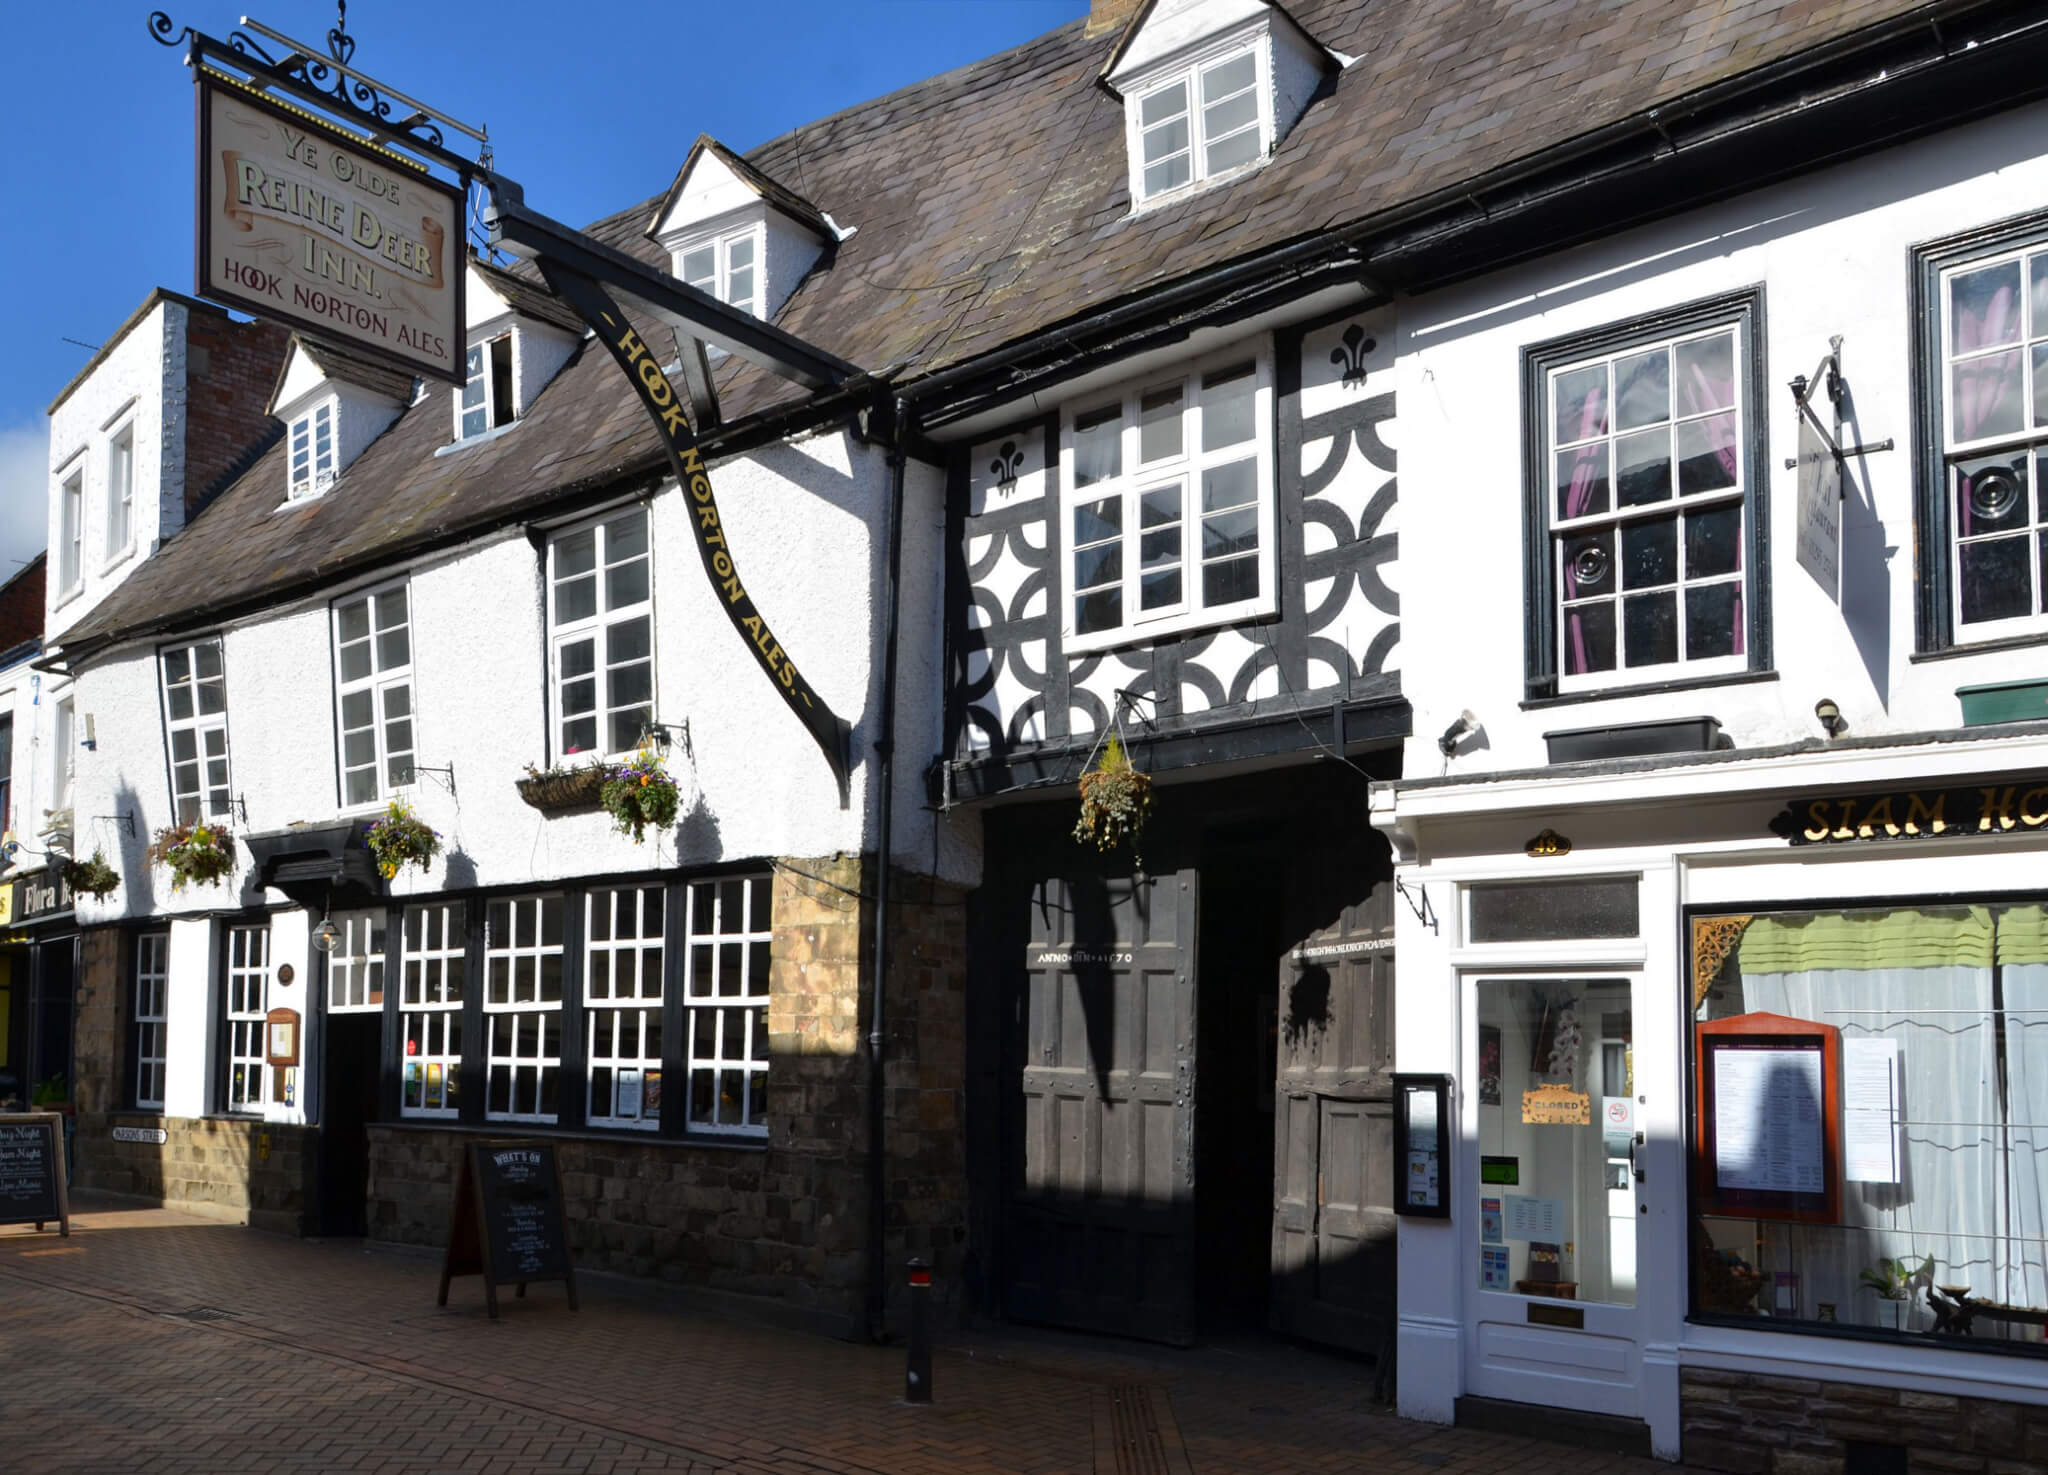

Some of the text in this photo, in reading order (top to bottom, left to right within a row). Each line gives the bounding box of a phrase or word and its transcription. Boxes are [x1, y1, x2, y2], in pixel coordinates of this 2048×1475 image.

[277, 123, 401, 206] YE OLDE
[236, 159, 434, 278] REINE DEER
[224, 257, 449, 361] HOOK NORTON ALES.
[618, 328, 688, 438] HOOK
[679, 445, 746, 605] NORTON
[1803, 793, 1946, 842] SIAM
[24, 884, 55, 915] Flora
[529, 1152, 541, 1164] ON
